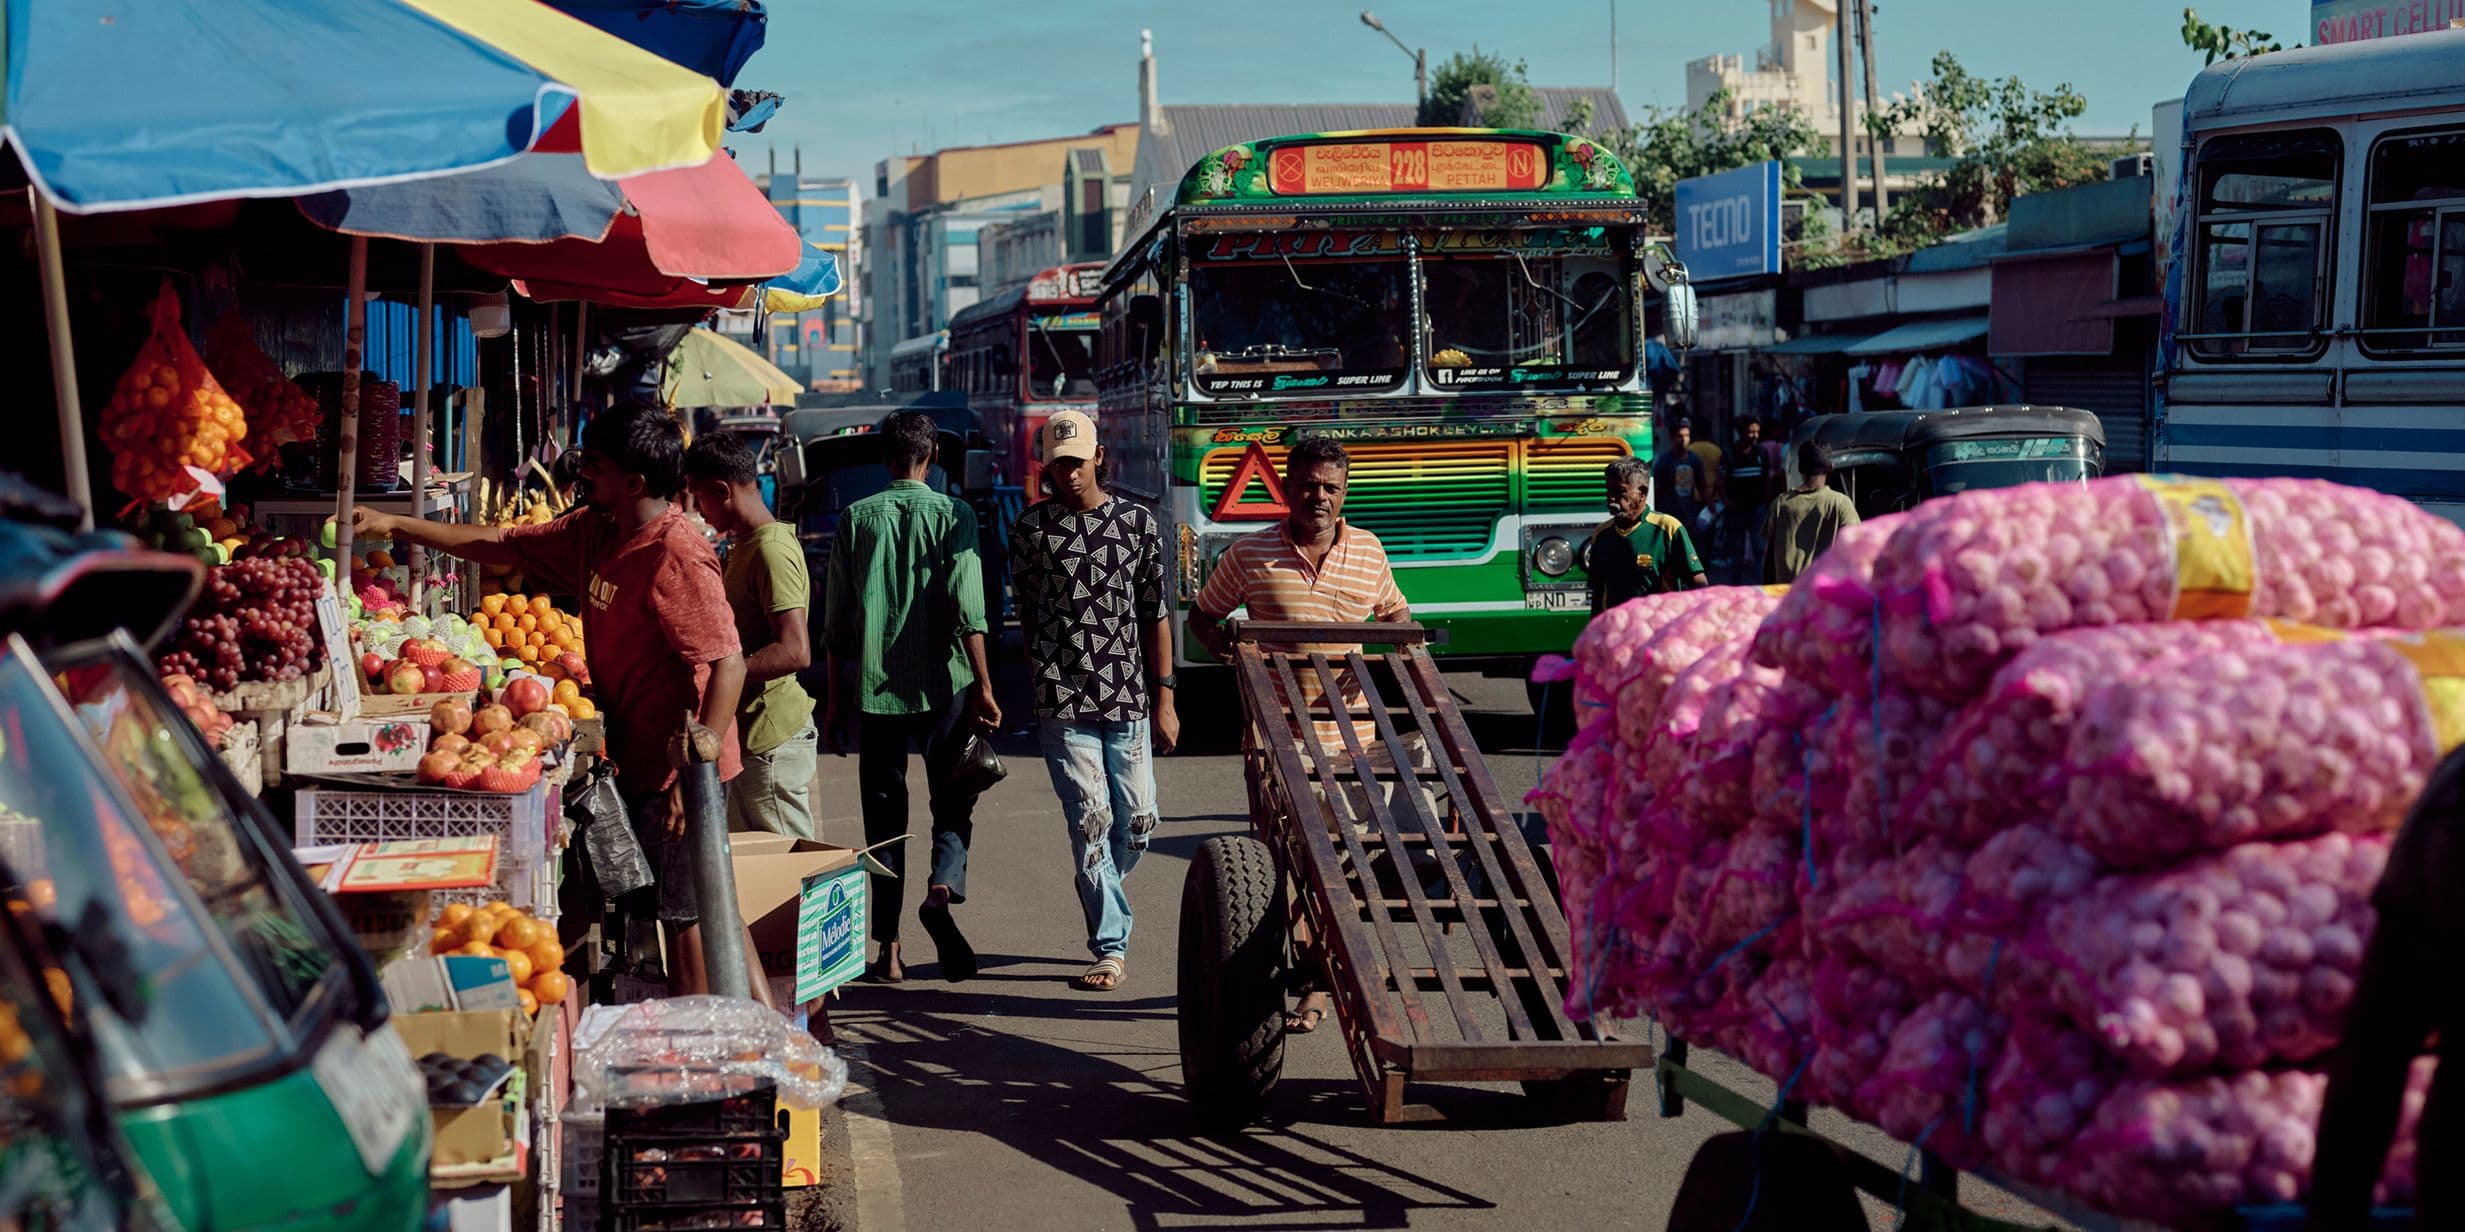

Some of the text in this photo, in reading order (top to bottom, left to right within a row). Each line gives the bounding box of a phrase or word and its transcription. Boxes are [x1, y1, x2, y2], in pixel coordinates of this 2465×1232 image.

[2318, 8, 2387, 44] SMART
[1392, 149, 1426, 184] 228
[1311, 176, 1386, 187] WELIWERIYA
[1446, 174, 1496, 185] PETTAH
[1688, 194, 1751, 251] TECNO
[1337, 375, 1392, 385] SUPER LINE
[1567, 370, 1620, 380] SUPER LINE
[1210, 379, 1263, 390] YEP THIS IS
[1377, 424, 1440, 437] ASHOK
